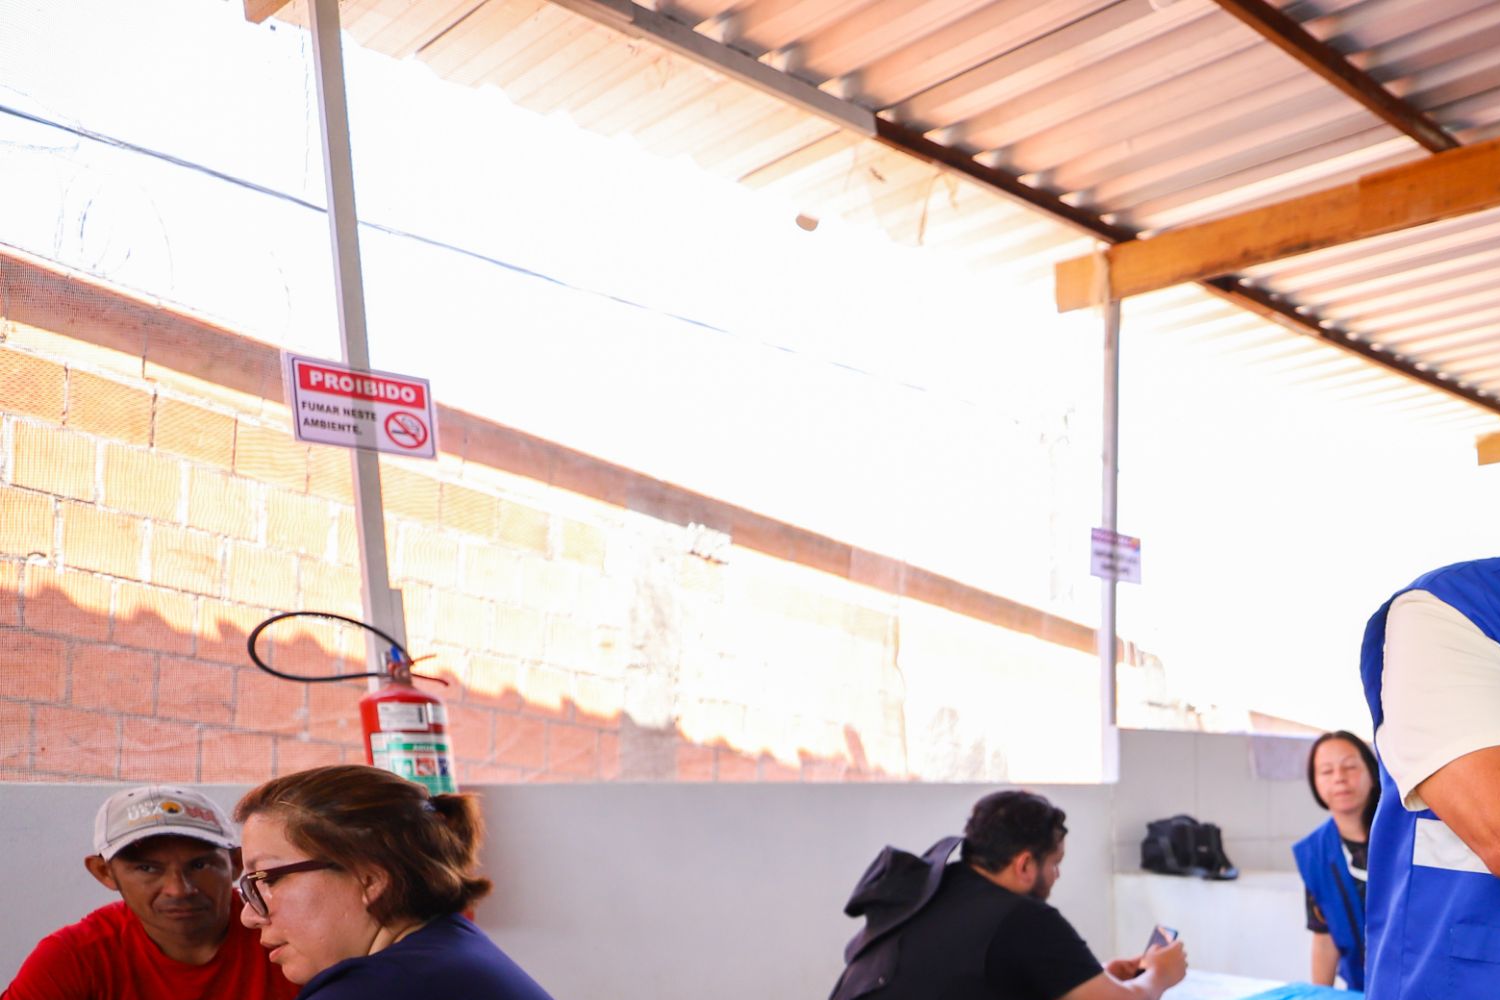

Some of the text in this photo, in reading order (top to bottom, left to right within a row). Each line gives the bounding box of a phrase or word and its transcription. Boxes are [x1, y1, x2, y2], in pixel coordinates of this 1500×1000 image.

[309, 369, 417, 403] PROIBIDO
[301, 400, 377, 422] FUMAR NESTE
[302, 417, 363, 436] AMBIENTE.
